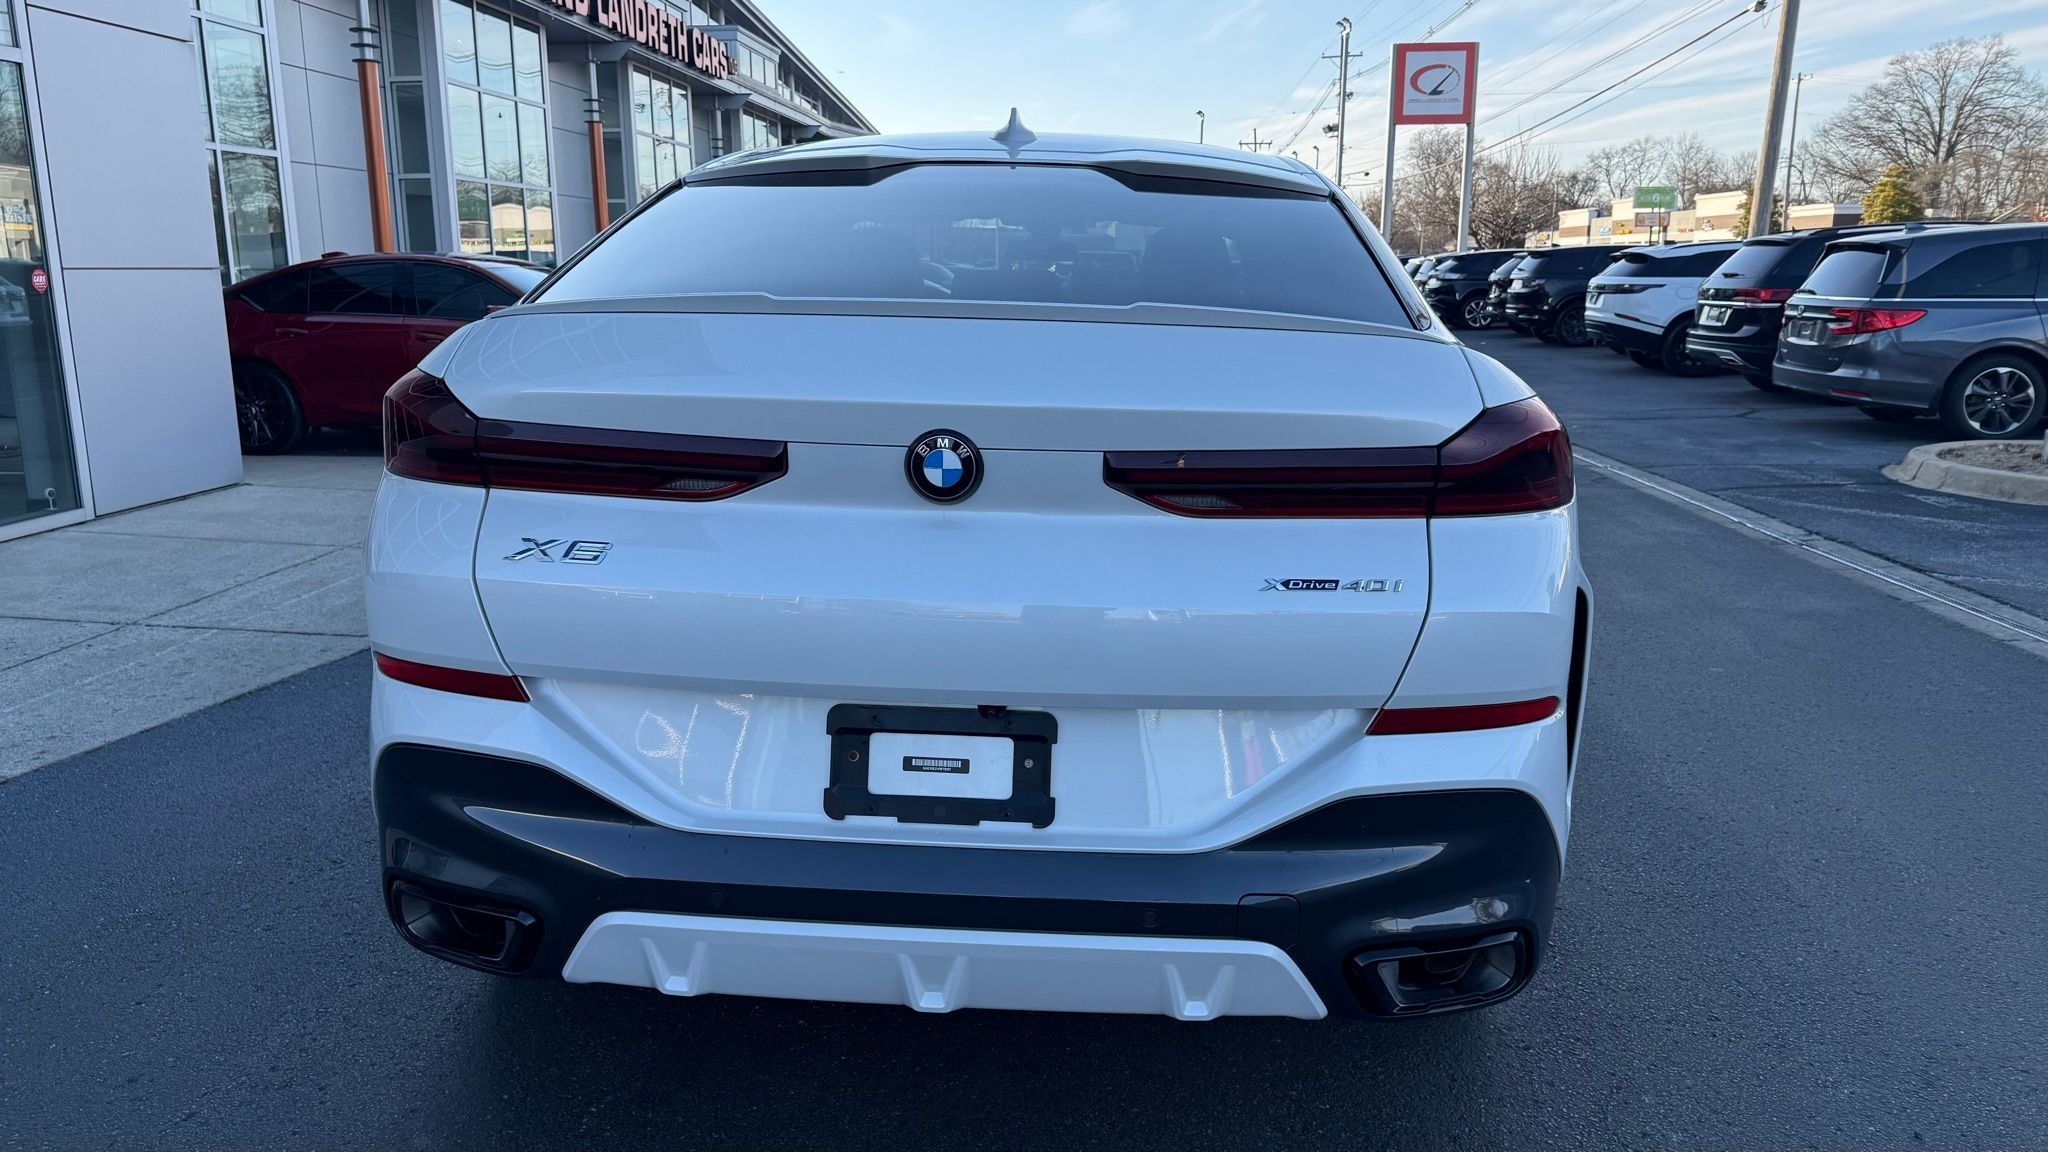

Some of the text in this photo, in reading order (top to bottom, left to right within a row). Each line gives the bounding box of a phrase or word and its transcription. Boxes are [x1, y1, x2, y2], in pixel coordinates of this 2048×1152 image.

[597, 0, 689, 63] LANDRETH
[692, 27, 728, 80] CARS
[917, 437, 970, 459] BMW
[502, 537, 614, 565] X6
